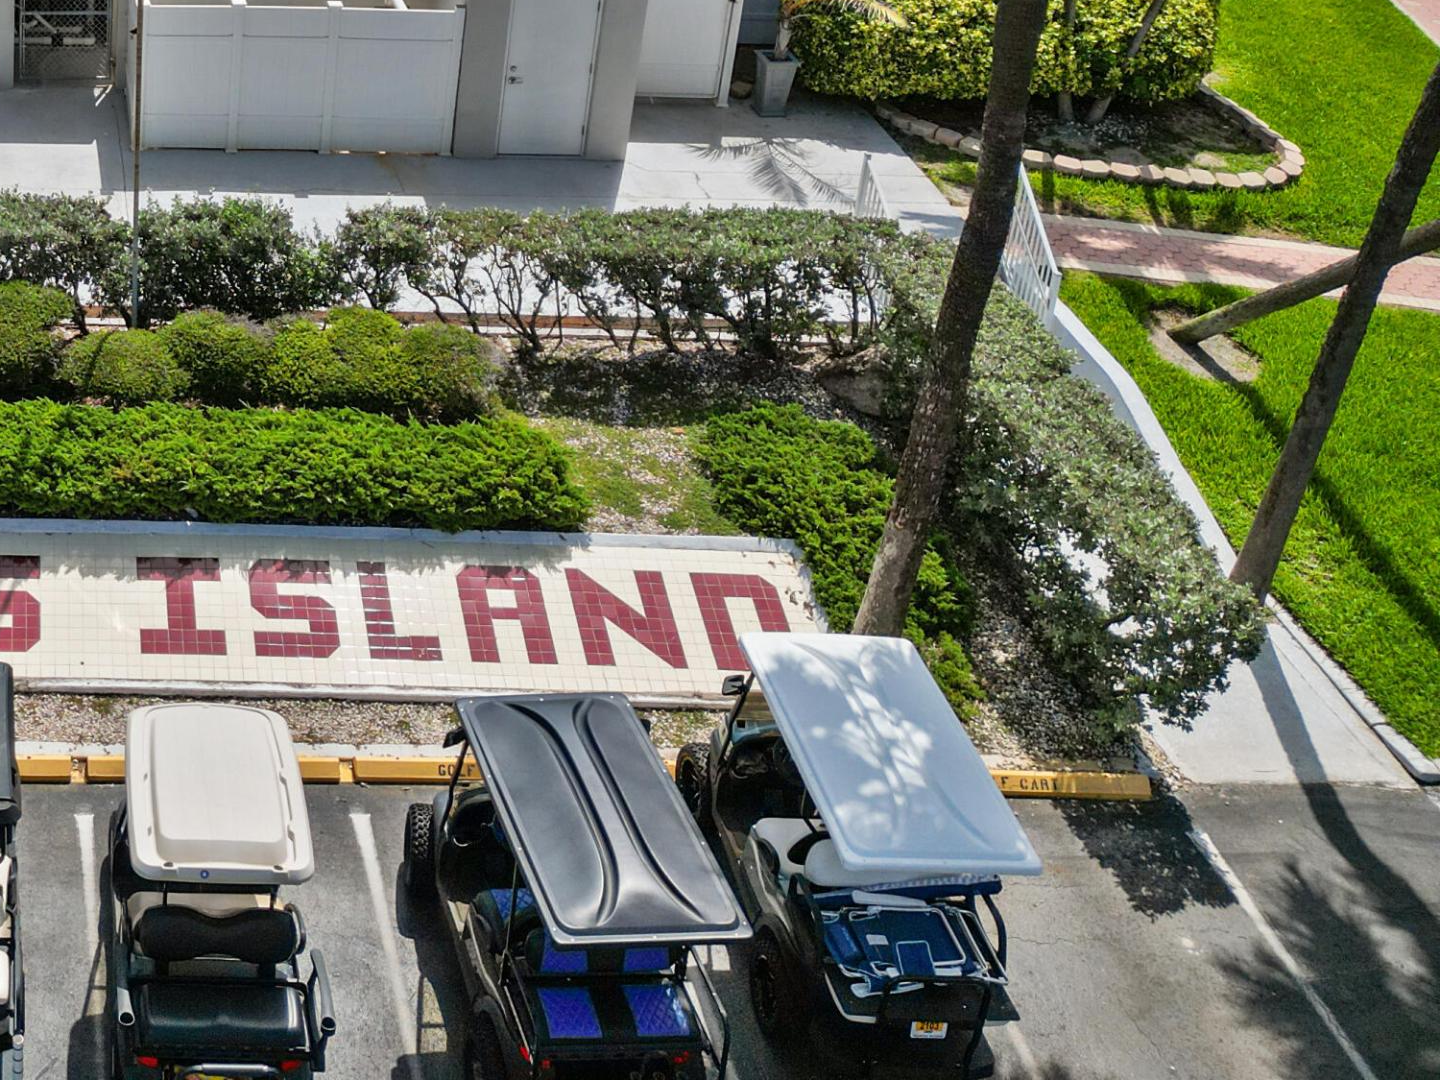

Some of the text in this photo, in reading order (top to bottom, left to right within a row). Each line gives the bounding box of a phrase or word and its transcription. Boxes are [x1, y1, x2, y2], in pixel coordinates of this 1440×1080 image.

[136, 557, 791, 670] ISLAND
[438, 764, 476, 778] GOF
[1020, 777, 1058, 791] CART
